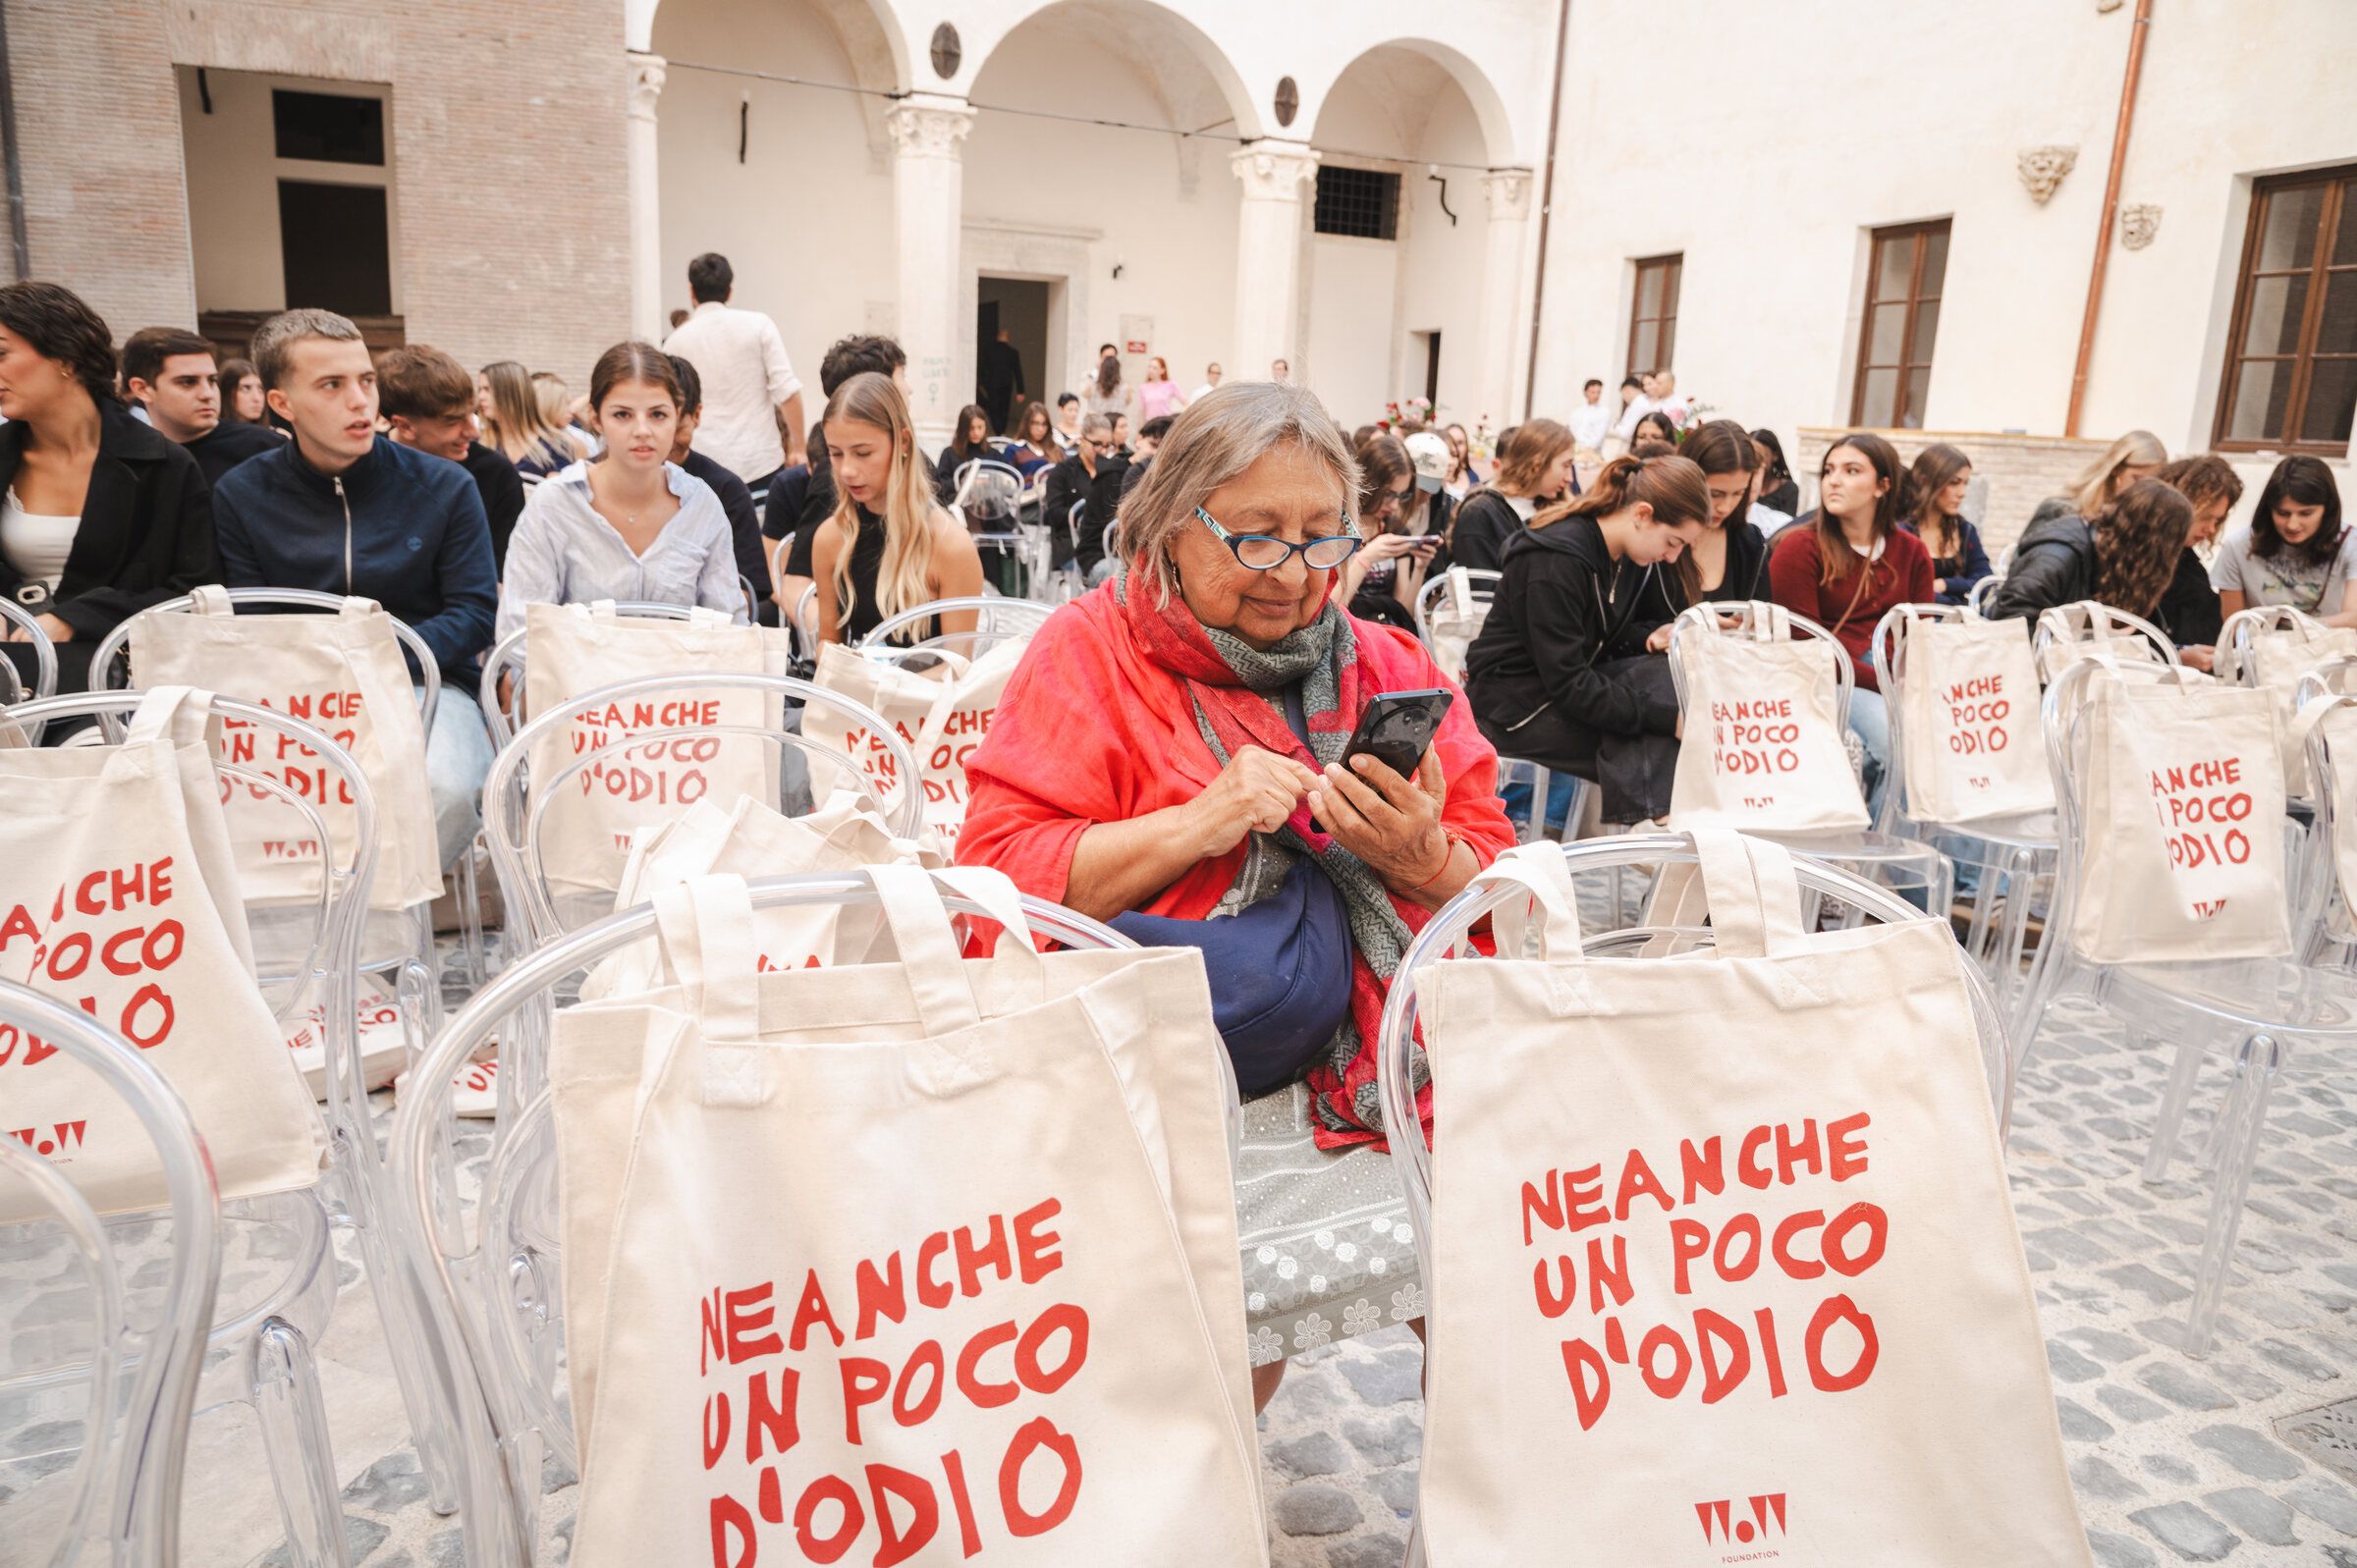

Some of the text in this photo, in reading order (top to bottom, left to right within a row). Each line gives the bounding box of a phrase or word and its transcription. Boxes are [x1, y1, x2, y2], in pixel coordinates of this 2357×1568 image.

[1733, 724, 1799, 745] POCO
[1950, 700, 2009, 727] POCO
[580, 762, 707, 805] D'ODIO
[2149, 758, 2240, 797] ANCHE
[2168, 792, 2252, 827] POCO
[2165, 829, 2250, 871] ODIO
[1521, 1112, 1870, 1246] NEANCHE
[1534, 1202, 1889, 1319] UN POCO
[701, 1197, 1063, 1377] NEANCHE
[1561, 1293, 1880, 1431] D'ODIO
[703, 1303, 1089, 1470] UN POCO
[710, 1416, 1082, 1568] D'ODIO
[1722, 1549, 1780, 1563] FOUNDATION
